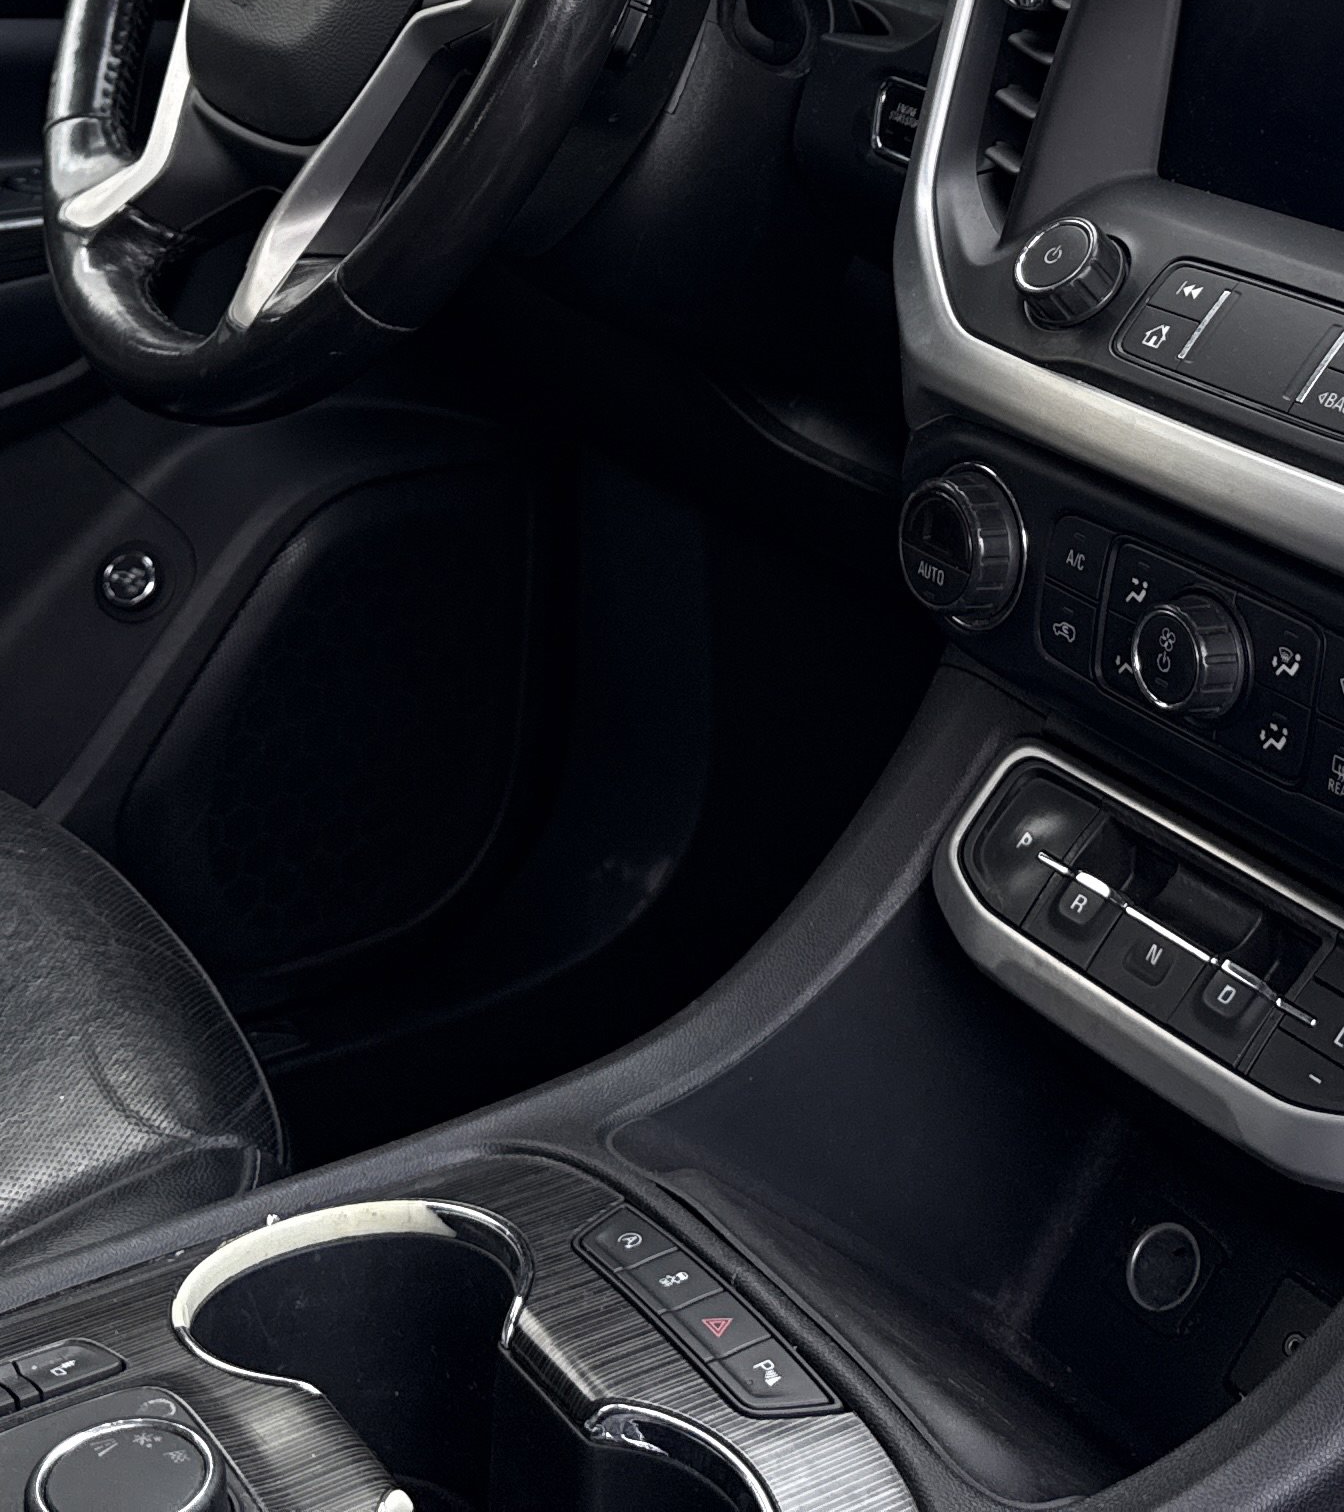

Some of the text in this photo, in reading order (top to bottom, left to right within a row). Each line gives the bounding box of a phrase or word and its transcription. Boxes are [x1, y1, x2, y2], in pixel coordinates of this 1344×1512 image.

[1065, 549, 1086, 571] A/C
[917, 560, 945, 586] AUTO
[1016, 831, 1033, 849] P
[1069, 893, 1088, 914] R
[1145, 943, 1163, 966] N
[1217, 984, 1237, 1005] D
